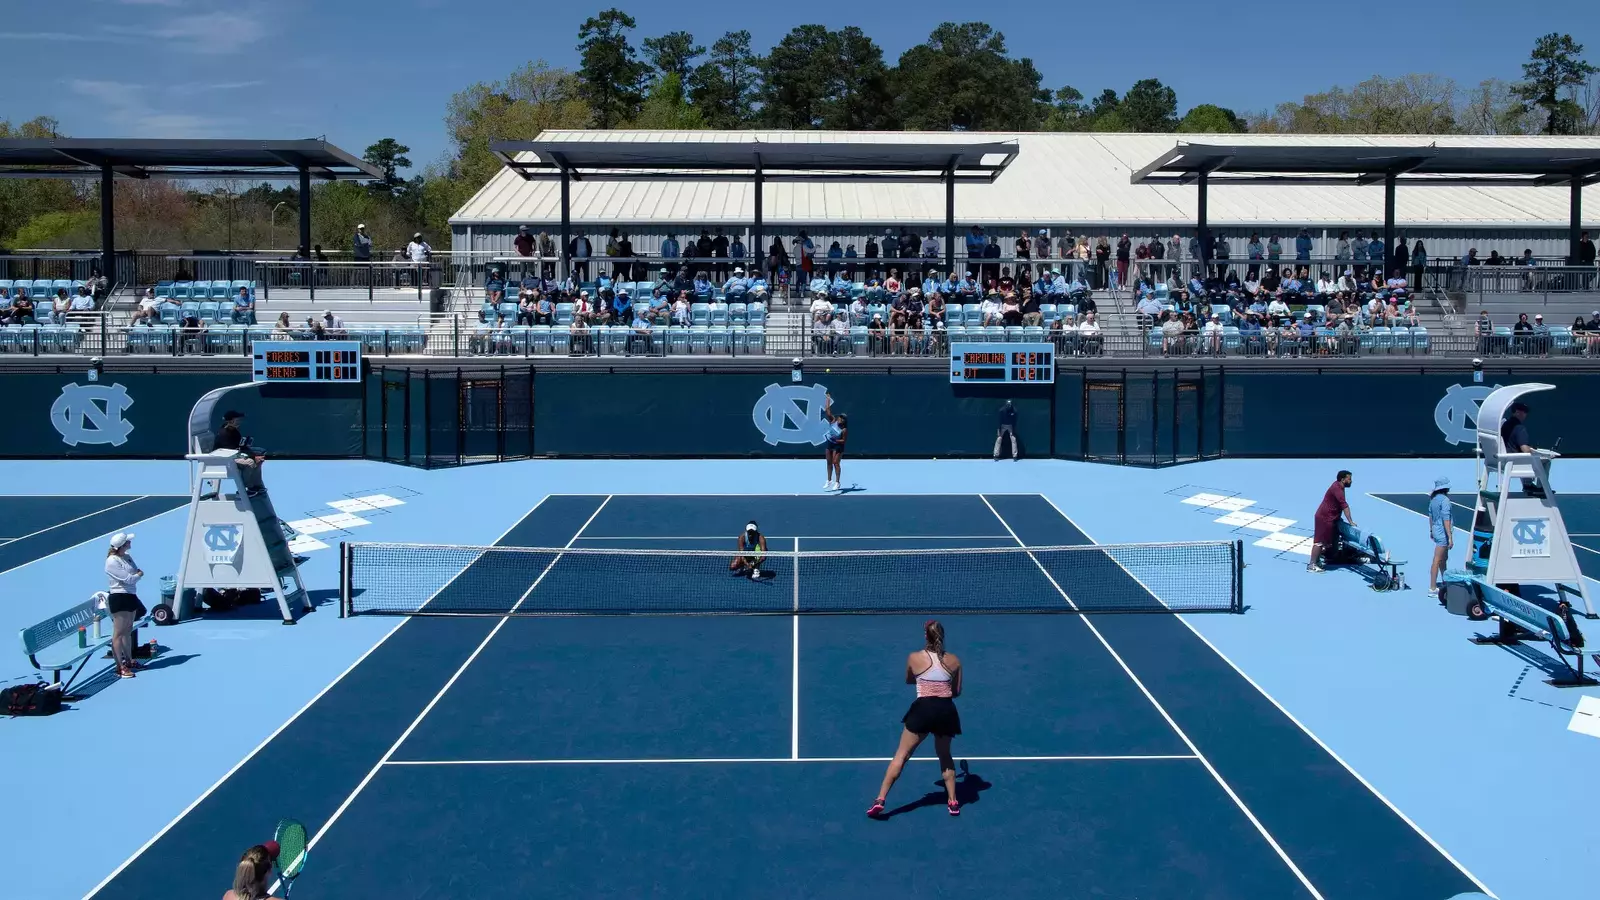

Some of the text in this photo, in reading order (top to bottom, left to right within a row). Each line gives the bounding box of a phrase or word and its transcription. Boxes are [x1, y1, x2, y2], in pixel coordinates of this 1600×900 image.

[266, 351, 300, 362] FORBES
[964, 353, 1006, 364] CAROLINA
[266, 366, 296, 378] CHENG
[964, 368, 979, 379] UT
